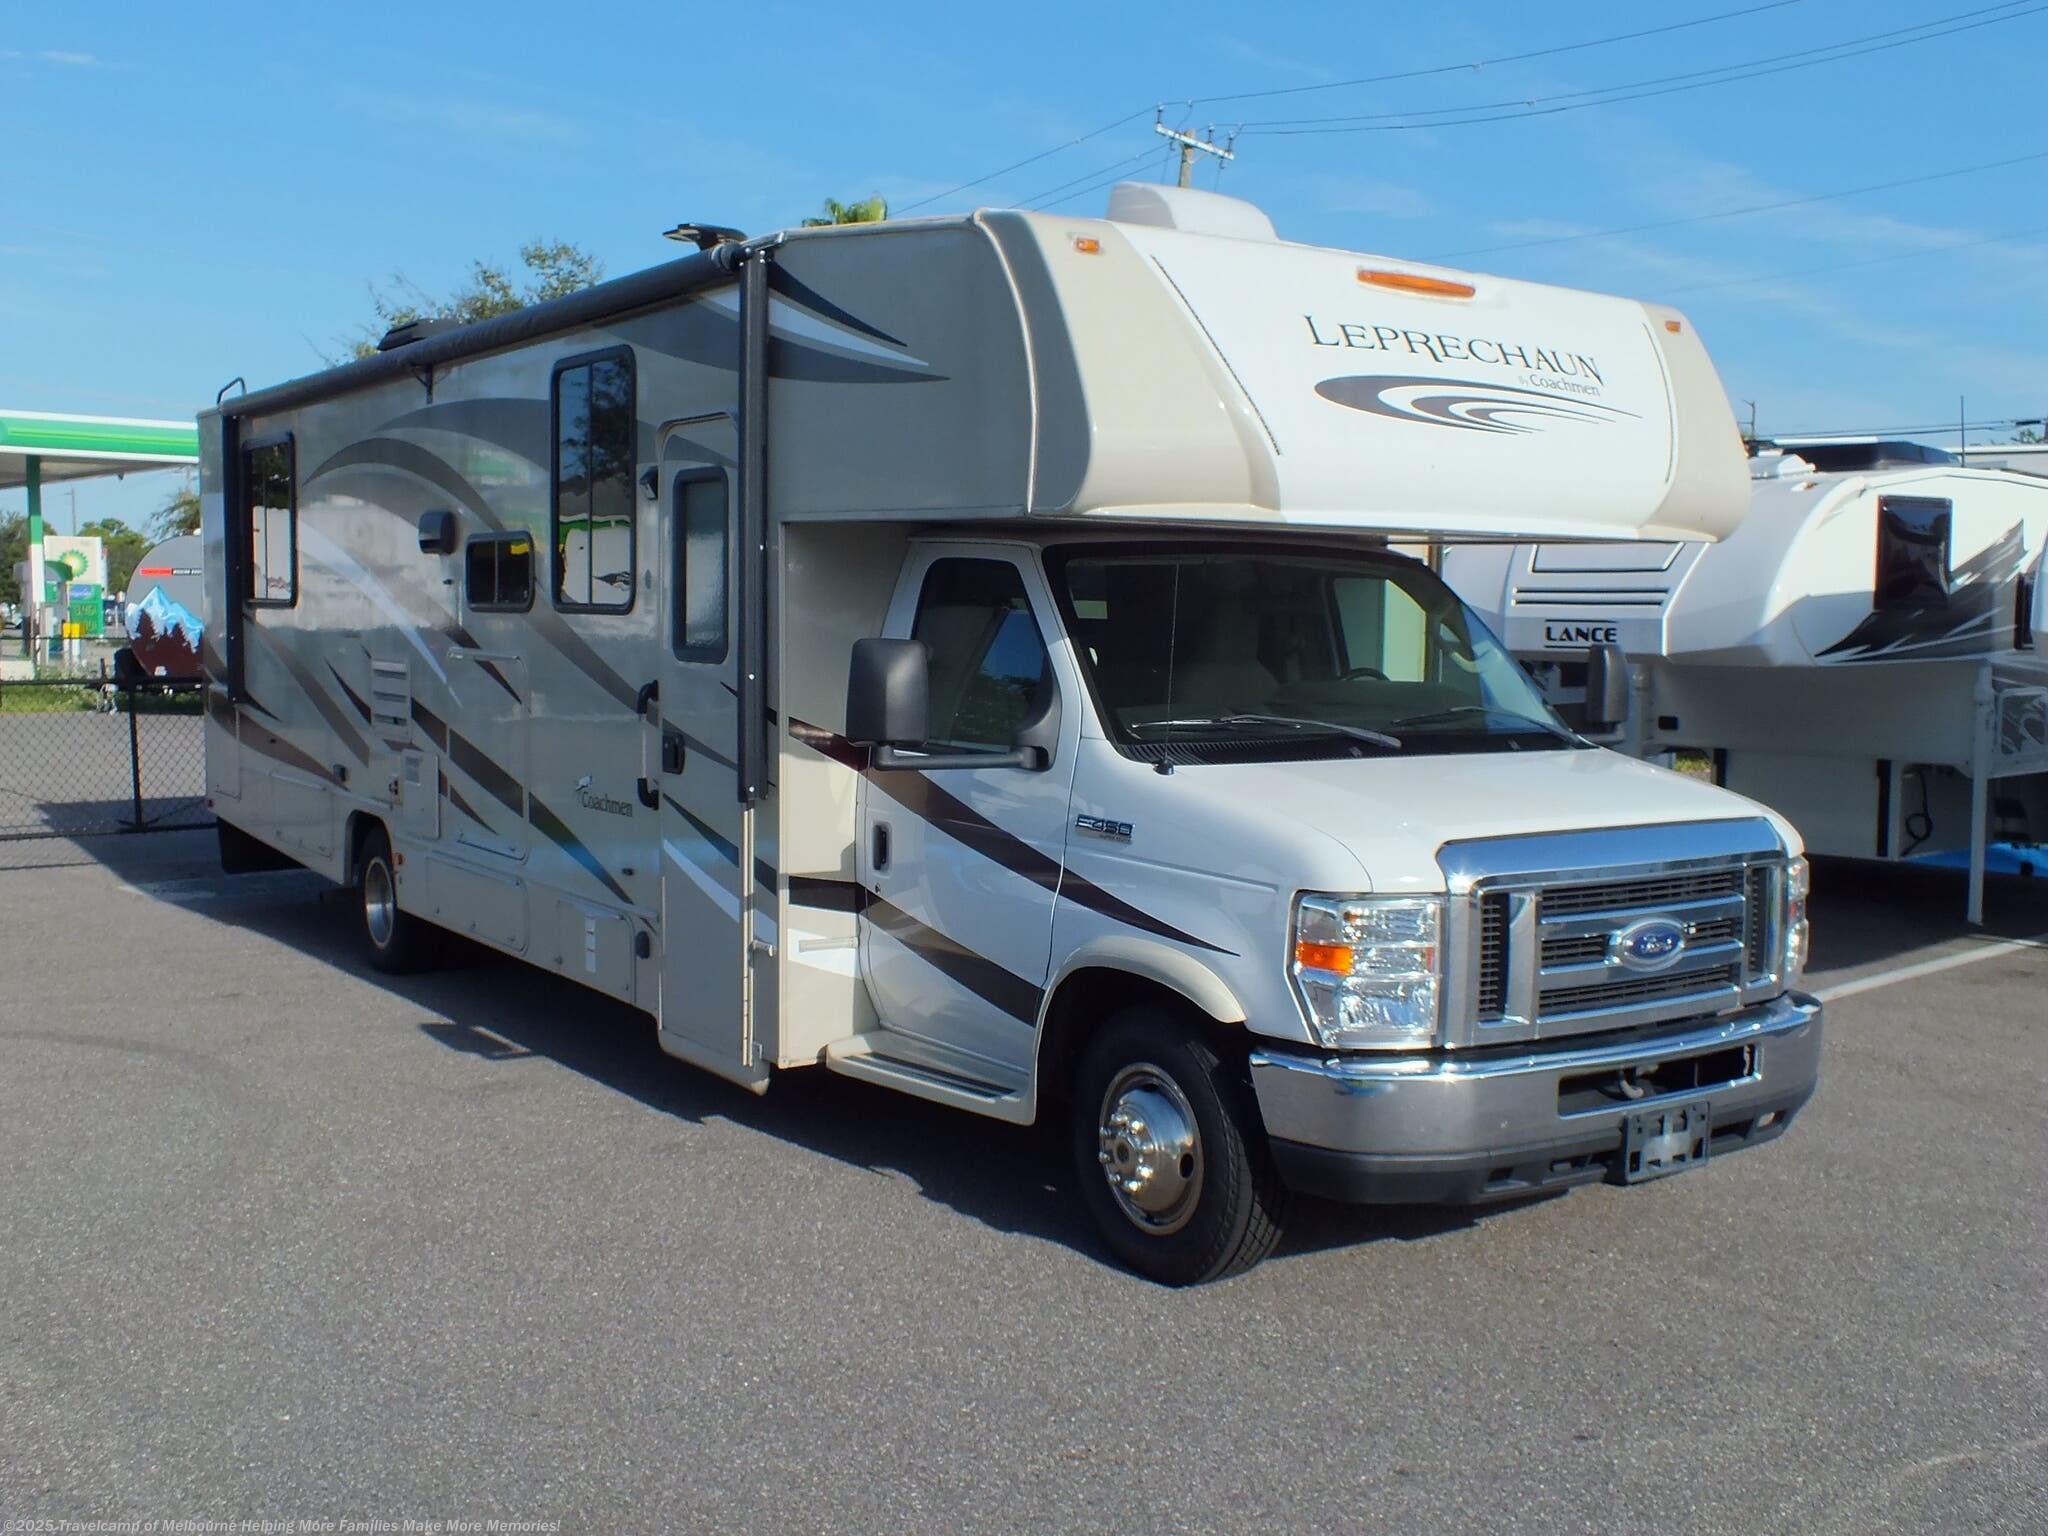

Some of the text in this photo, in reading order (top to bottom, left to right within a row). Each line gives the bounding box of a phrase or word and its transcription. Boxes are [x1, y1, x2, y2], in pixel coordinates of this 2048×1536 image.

[1303, 315, 1604, 385] LEPRECHAUN
[1529, 374, 1600, 396] Coachmen
[1545, 626, 1617, 643] LANCE
[582, 791, 633, 817] Coachmen
